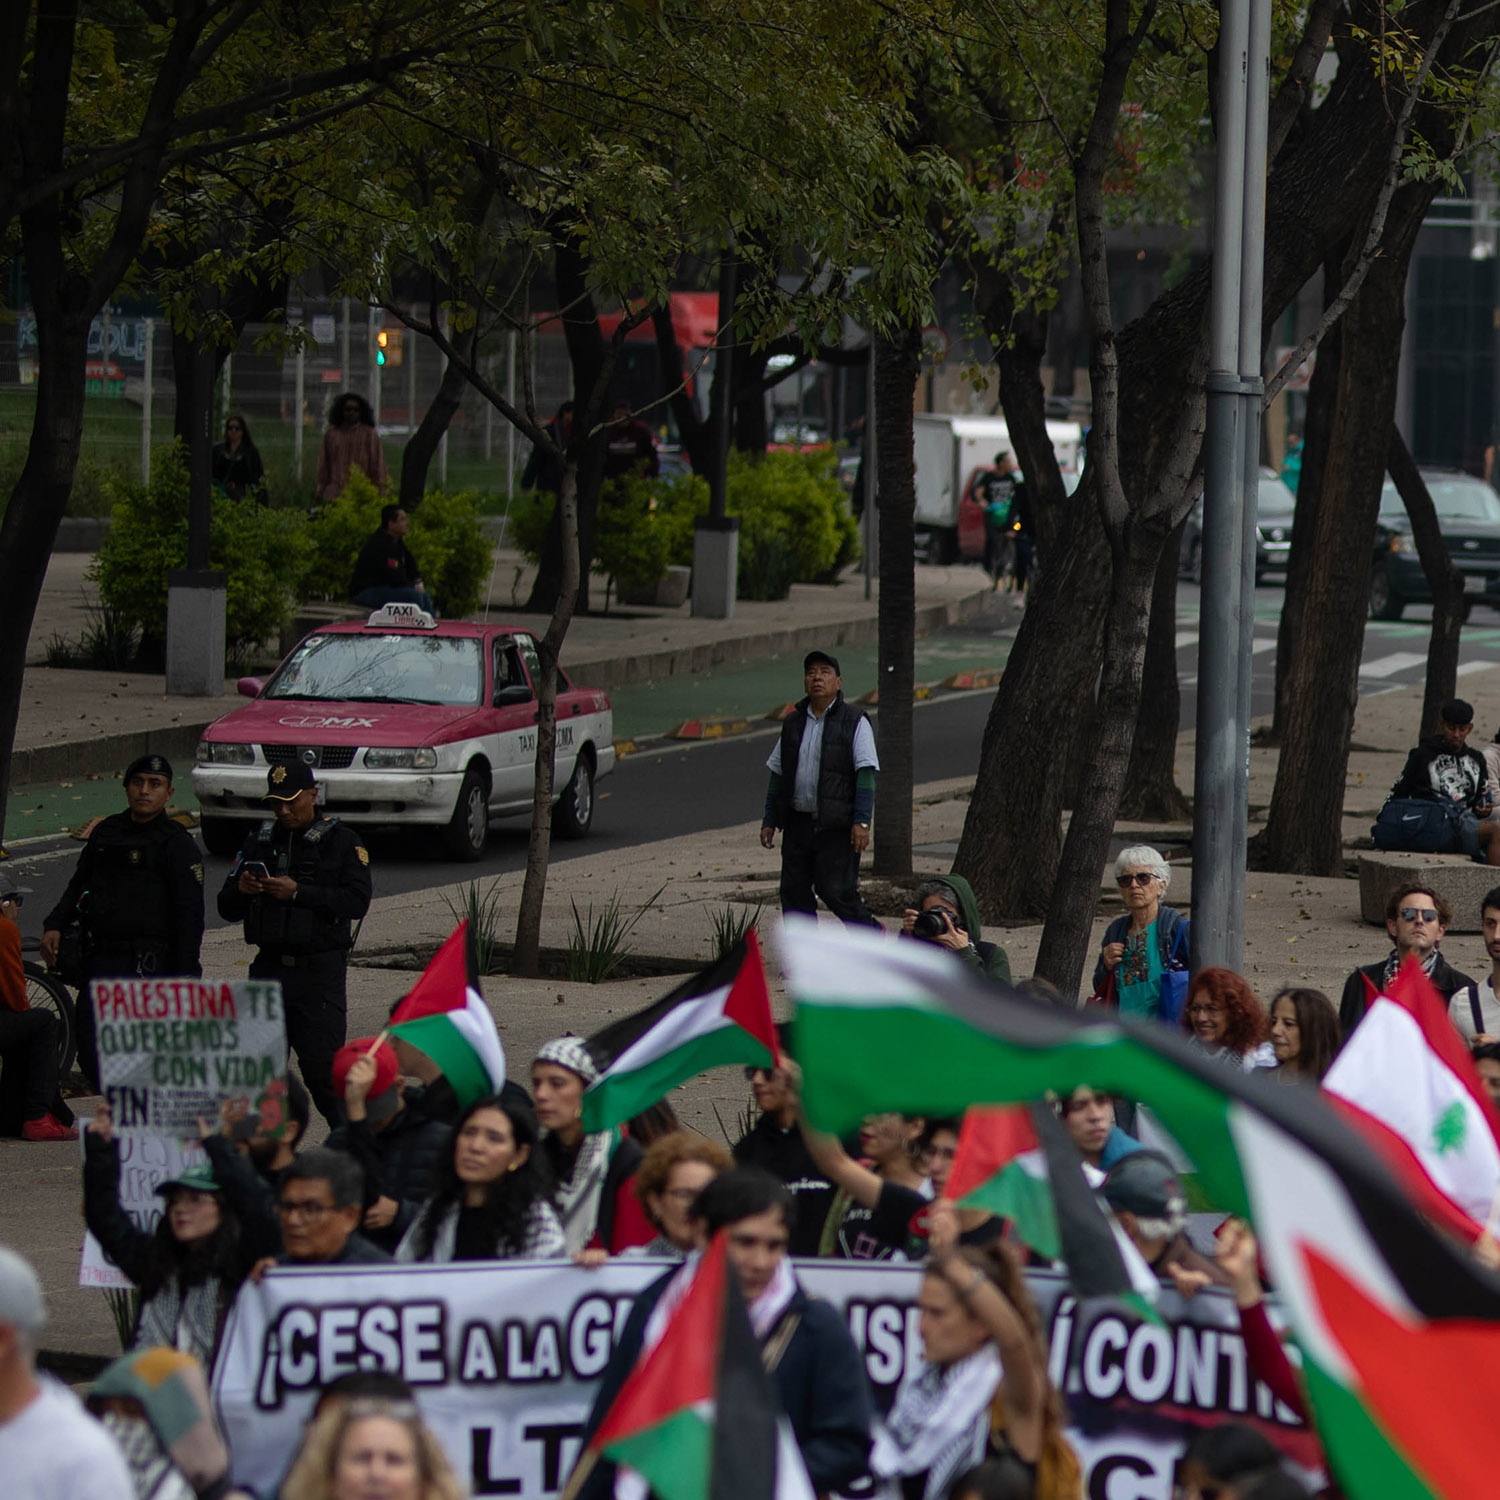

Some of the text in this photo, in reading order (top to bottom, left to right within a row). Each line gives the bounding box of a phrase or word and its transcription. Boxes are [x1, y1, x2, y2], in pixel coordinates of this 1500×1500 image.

[386, 605, 413, 616] TAXI
[519, 734, 535, 752] TAXI
[97, 983, 278, 1021] PALESTINA TE
[100, 1020, 239, 1055] QUEREMOS
[153, 1054, 277, 1087] CON VIDA
[107, 1085, 149, 1128] FIN
[257, 1299, 448, 1409] ¡CESE
[459, 1321, 501, 1385] A
[502, 1317, 564, 1383] LA
[1082, 1312, 1303, 1425] CONT
